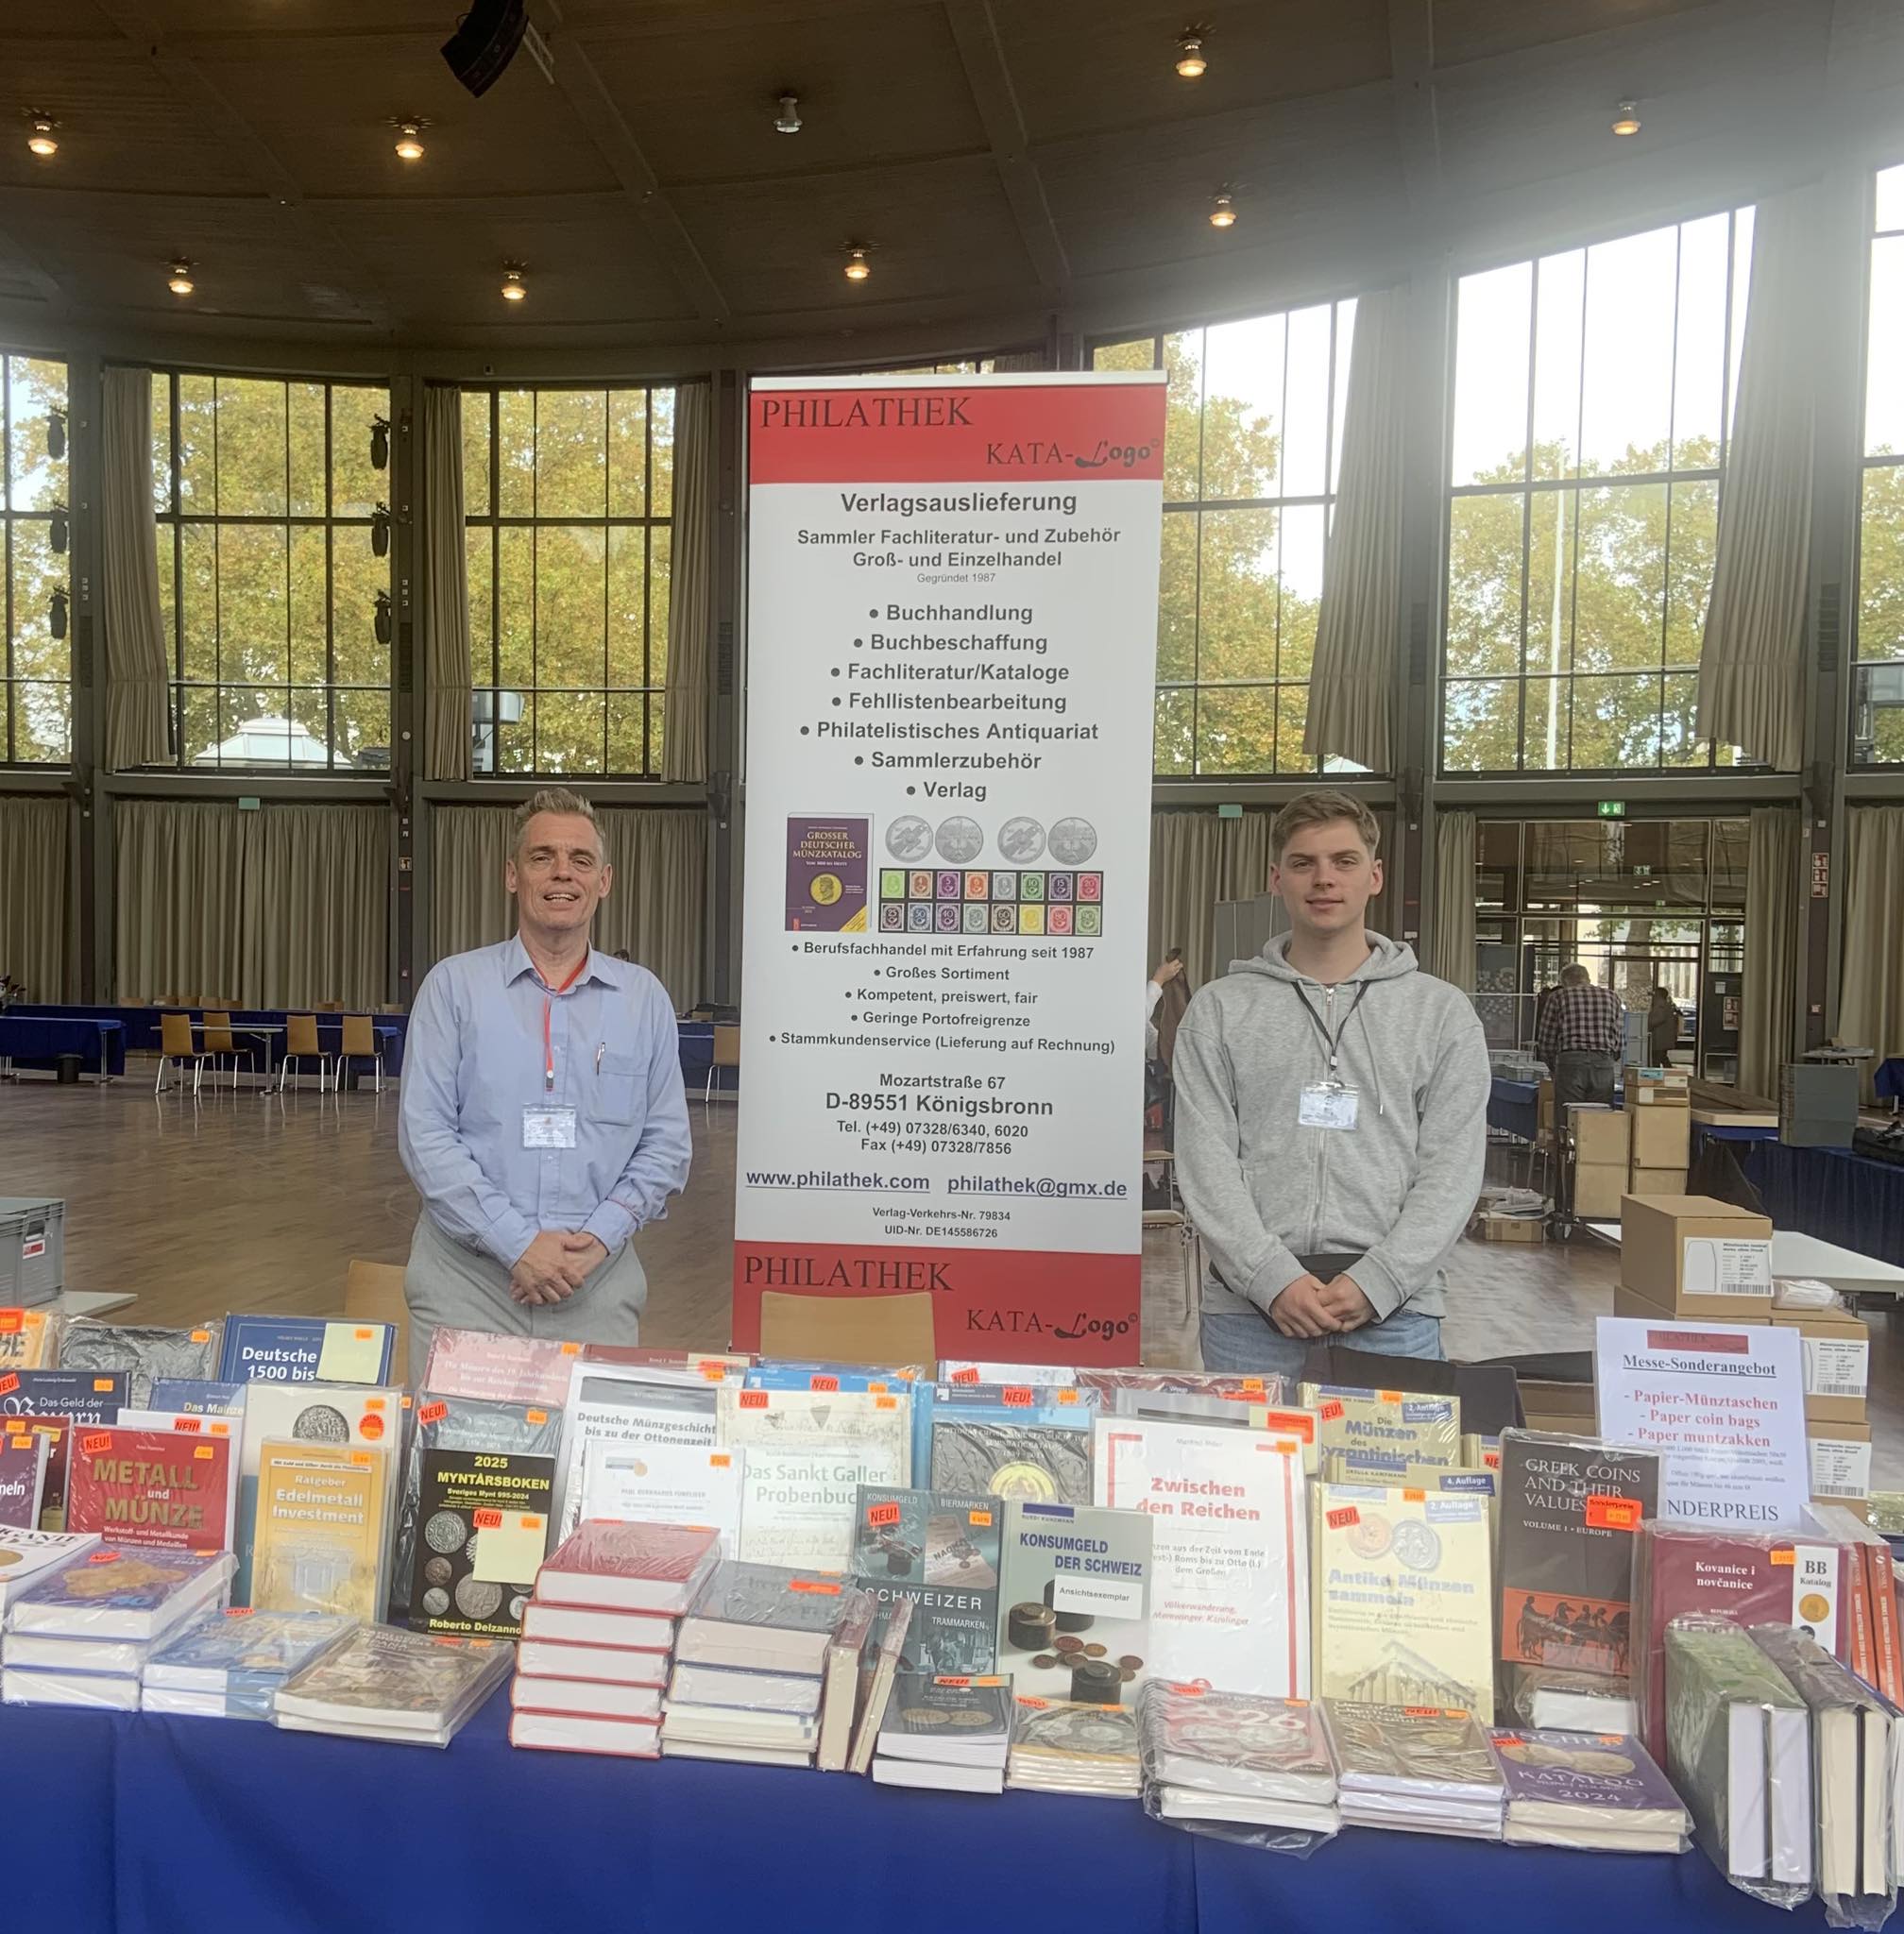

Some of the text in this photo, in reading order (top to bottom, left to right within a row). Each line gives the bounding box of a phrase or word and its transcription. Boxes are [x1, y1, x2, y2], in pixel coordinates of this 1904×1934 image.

[761, 397, 973, 428] PHILATHEK
[841, 492, 1078, 517] Verlagsauslieferung
[797, 527, 1121, 545] Sammler Fachliteratur- und Zubehör
[853, 551, 1062, 568] Groß- und Einzelhandel
[917, 573, 995, 585] Gegründet 1987
[887, 604, 1033, 624] Buchhandlung
[872, 634, 1047, 653] Buchbeschaffung
[848, 663, 1069, 685] Fachliteratur/Kataloge
[849, 692, 1066, 714] Fehllistenbearbeitung
[817, 721, 1098, 743] Philatelistisches Antiquariat
[872, 752, 1042, 770] Sammlerzubehör
[924, 781, 987, 802] Verlag
[807, 831, 848, 840] GROSSER
[801, 840, 855, 849] DEUTSCHER
[793, 850, 862, 859] MÜNZKATALOG
[804, 942, 1094, 960] Berufsfachhandel mit Erfahrung seit 1987
[886, 966, 1010, 980] Großes Sortiment
[858, 989, 1038, 1006] Kompetent, preiswert, fair
[863, 1011, 1030, 1029] Geringe Portofreigrenze
[781, 1032, 1115, 1055] Stammkundenservice (Lieferung auf Rechnung)
[879, 1074, 1006, 1090] Mozartstraße 67
[826, 1094, 1053, 1117] D-89551 Königsbronn
[837, 1120, 1028, 1138] Tel. (+49) 07328/6340, 6020
[861, 1139, 1012, 1155] Fax (+49) 07328/7856
[746, 1171, 1128, 1198] www.philathek.com philathek@gmx.de
[873, 1208, 1011, 1221] Verlag-Verkehrs-Nr. 79834
[884, 1225, 998, 1238] UID-Nr. DE145586726
[743, 1256, 953, 1292] PHILATHEK
[242, 1347, 317, 1364] Deutsche
[247, 1366, 314, 1381] 1500 bis
[1623, 1354, 1776, 1376] Messe-Sonderangebot
[811, 1378, 839, 1390] NEU!
[40, 1397, 104, 1408] Das Geld der
[741, 1394, 768, 1406] NEU!
[1004, 1392, 1032, 1403] NEU!
[1634, 1389, 1778, 1411] Papier-Münztaschen
[183, 1402, 204, 1413] Das
[420, 1405, 446, 1420] NEU!
[577, 1412, 629, 1426] Deutsche
[1377, 1417, 1392, 1425] Die
[1650, 1409, 1760, 1431] Paper coin bags
[585, 1427, 712, 1447] bis zu der Ottonenzeit
[1345, 1420, 1417, 1440] Münzen
[1638, 1428, 1771, 1448] Paper muntzakken
[86, 1435, 109, 1449] NEU!
[474, 1456, 508, 1469] 2025
[1525, 1459, 1640, 1483] GREEK COINS
[95, 1459, 198, 1490] METALL
[295, 1474, 347, 1488] Ratgeber
[437, 1471, 550, 1490] MYNTÅRSBOKEN
[776, 1465, 829, 1481] Sankt
[833, 1466, 887, 1483] Galler
[1455, 1476, 1486, 1485] Auflage
[147, 1489, 170, 1500] und
[447, 1488, 478, 1498] Sveriges
[479, 1490, 497, 1500] Mynt
[1150, 1477, 1246, 1498] Zwischen
[1524, 1477, 1624, 1499] AND THEIR
[276, 1488, 364, 1507] Edelmetall
[867, 1493, 918, 1504] KONSUMGELD
[941, 1498, 989, 1510] BIERMARKEN
[1440, 1501, 1473, 1511] Auflage
[1524, 1493, 1587, 1512] VALUES
[105, 1495, 203, 1530] MÜNZE
[272, 1506, 364, 1524] Investment
[870, 1508, 898, 1523] NEU!
[1136, 1499, 1261, 1520] den Reichen
[475, 1513, 502, 1526] NEU!
[1328, 1511, 1357, 1526] NEU!
[136, 1528, 149, 1536] und
[150, 1529, 188, 1540] Metallkunde
[1523, 1519, 1612, 1537] VOLUME EUROPE
[1020, 1533, 1109, 1554] KONSUMGELD
[1055, 1555, 1142, 1576] DER SCHWEIZ
[1175, 1555, 1198, 1565] Roms
[1200, 1556, 1212, 1565] bis
[1227, 1559, 1247, 1568] Otto
[1175, 1566, 1193, 1574] dem
[1695, 1561, 1756, 1576] Kovanice i
[1805, 1560, 1828, 1575] BB
[1398, 1573, 1474, 1594] Münzen
[1697, 1577, 1753, 1590] novčanice
[1800, 1577, 1832, 1588] Katalog
[1059, 1586, 1130, 1603] Ansichtsexemplar
[430, 1619, 471, 1631] Roberto
[932, 1617, 985, 1630] TRAMMARKEN
[1518, 1770, 1644, 1787] KATALOG
[1558, 1790, 1622, 1802] 2024
